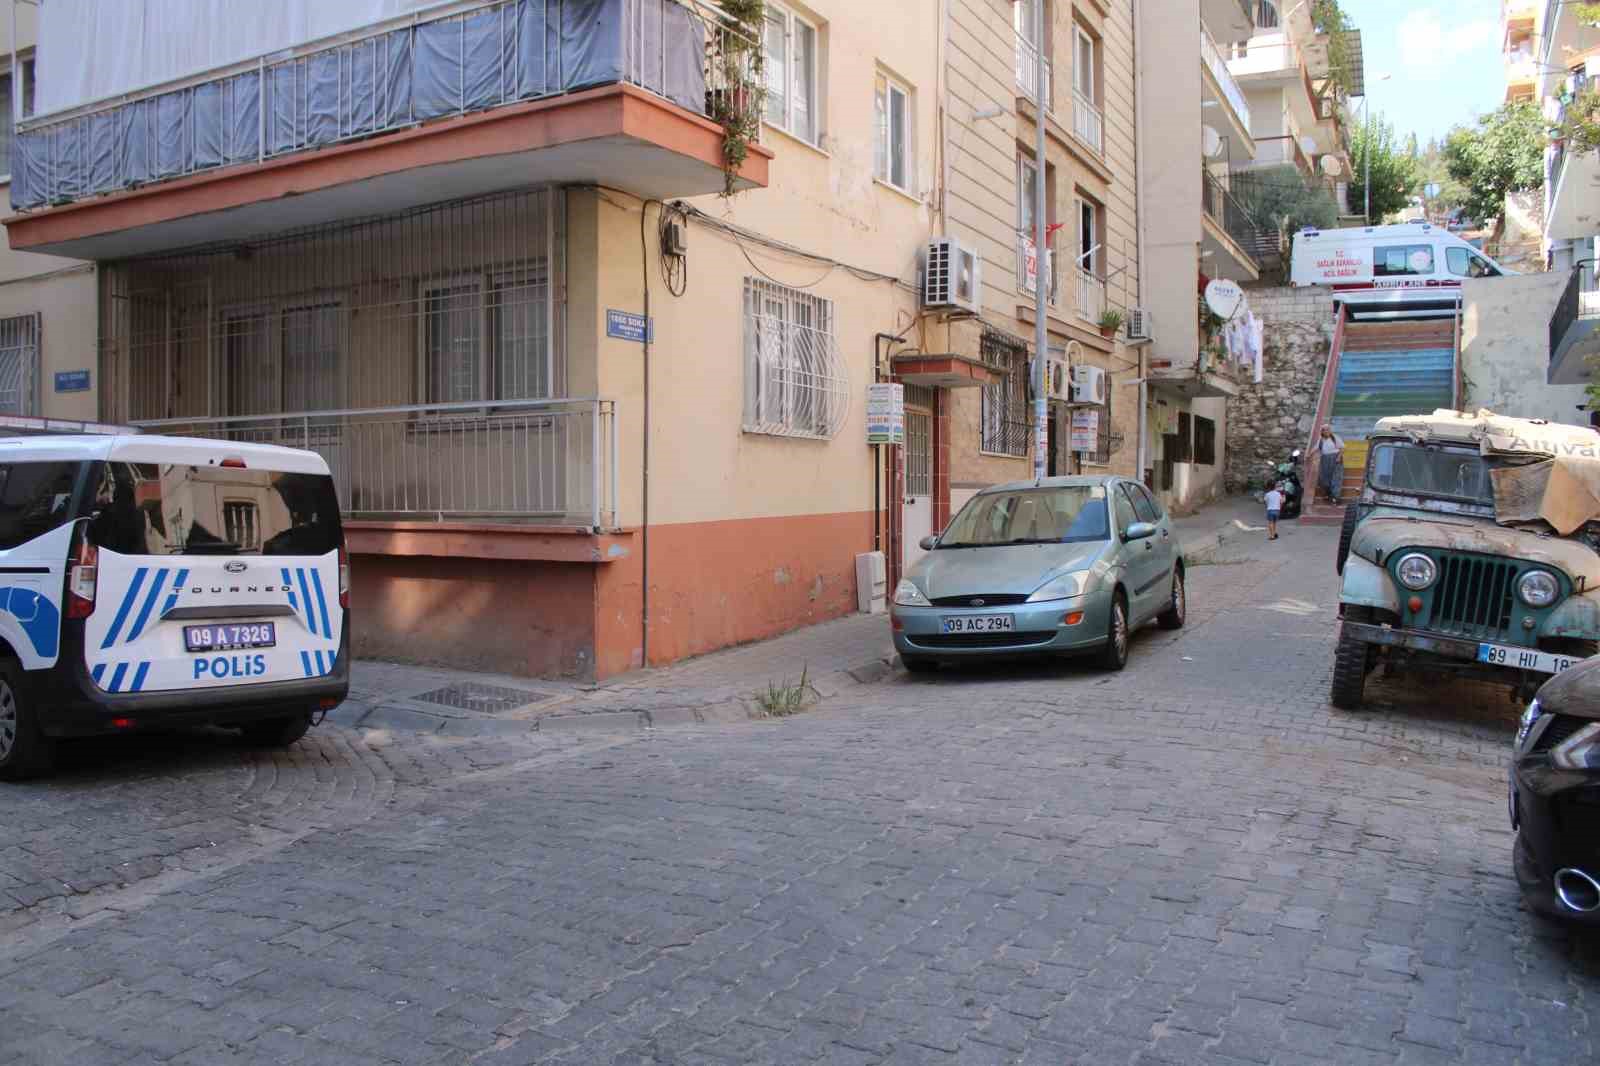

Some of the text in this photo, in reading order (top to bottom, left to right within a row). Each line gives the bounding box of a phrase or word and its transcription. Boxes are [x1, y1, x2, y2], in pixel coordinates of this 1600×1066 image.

[1509, 437, 1600, 458] Altiva
[173, 585, 290, 594] TOURNEO
[949, 617, 1010, 632] 09 AC 294
[191, 625, 270, 646] 09 A 7326
[1519, 651, 1538, 668] HU
